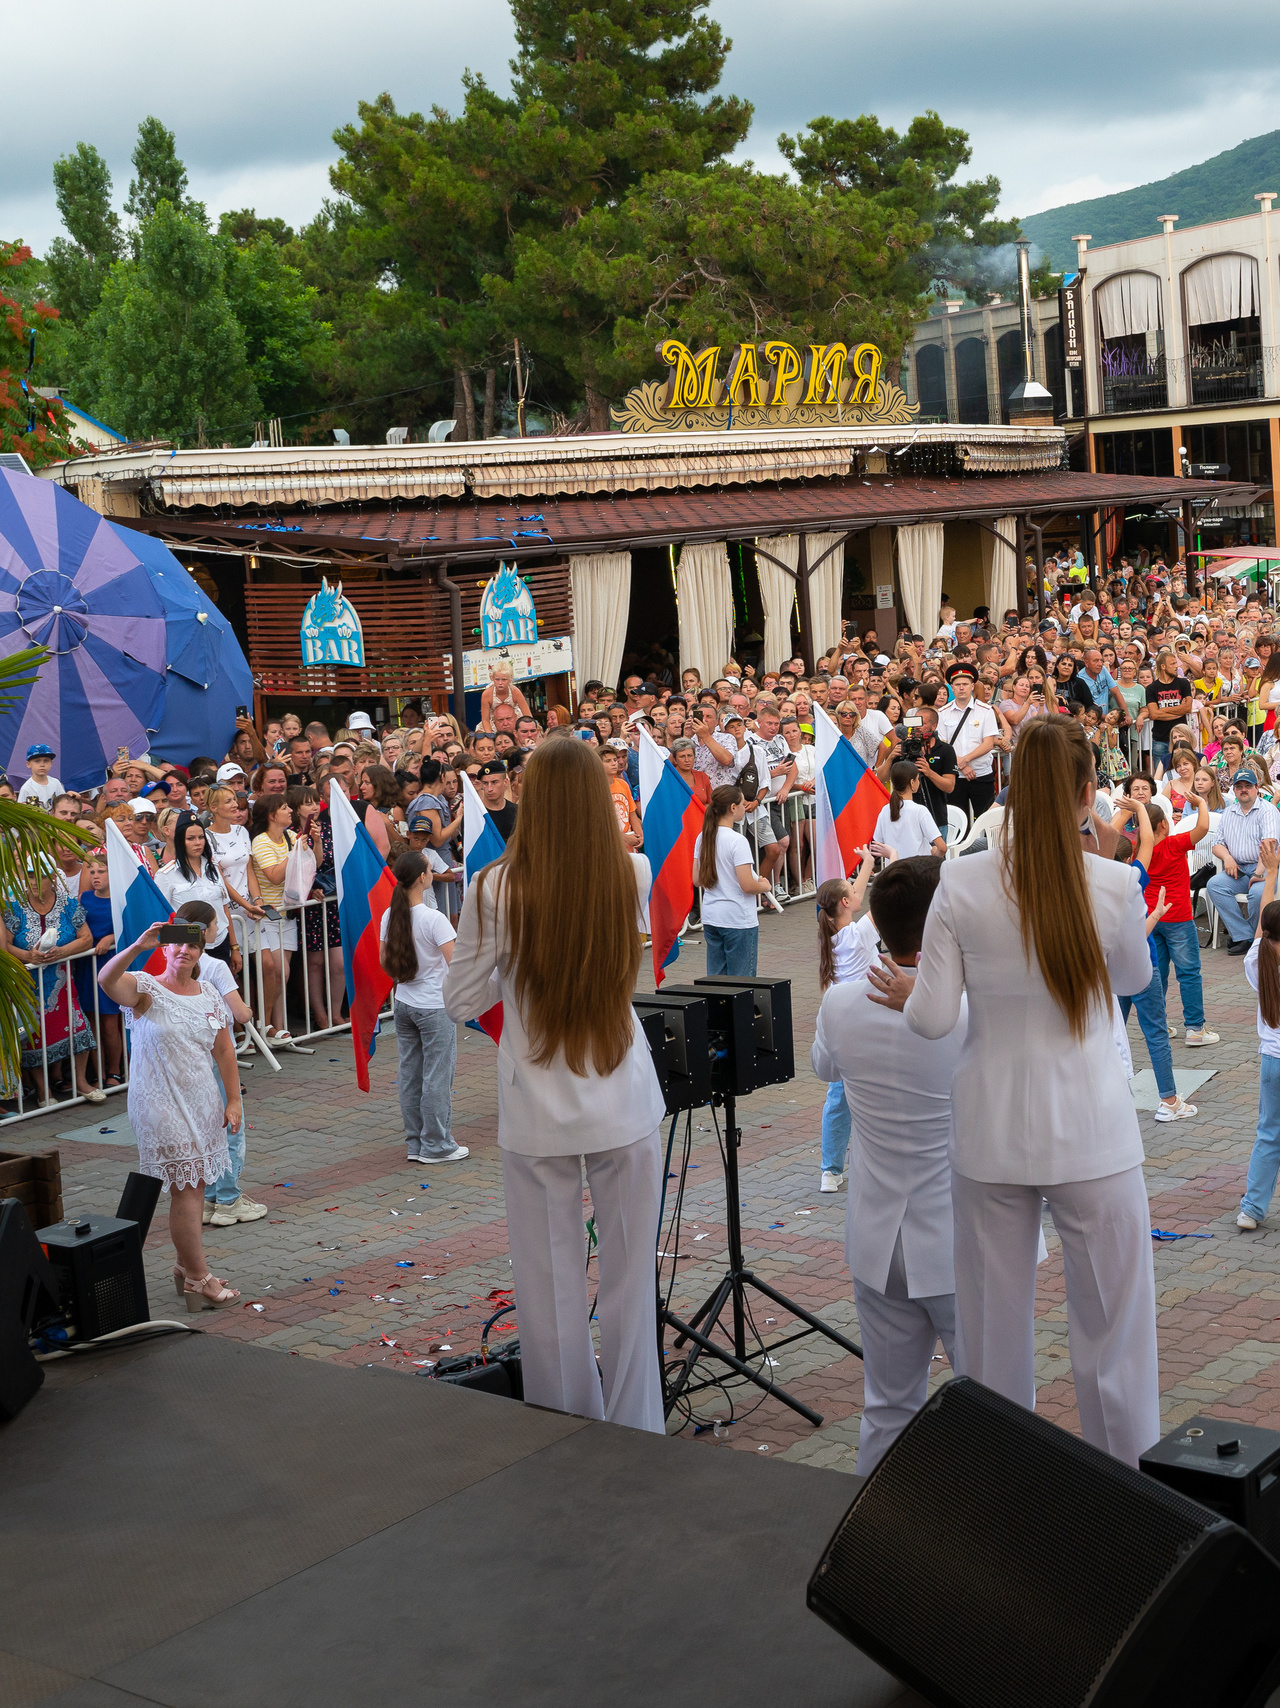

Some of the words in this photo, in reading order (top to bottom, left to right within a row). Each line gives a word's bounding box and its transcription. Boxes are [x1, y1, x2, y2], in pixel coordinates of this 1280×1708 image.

[1064, 290, 1077, 348] БАЛКОН
[655, 339, 882, 409] МАРИЯ
[486, 616, 536, 647] BAR
[304, 638, 360, 664] BAR
[1157, 692, 1178, 701] NEW
